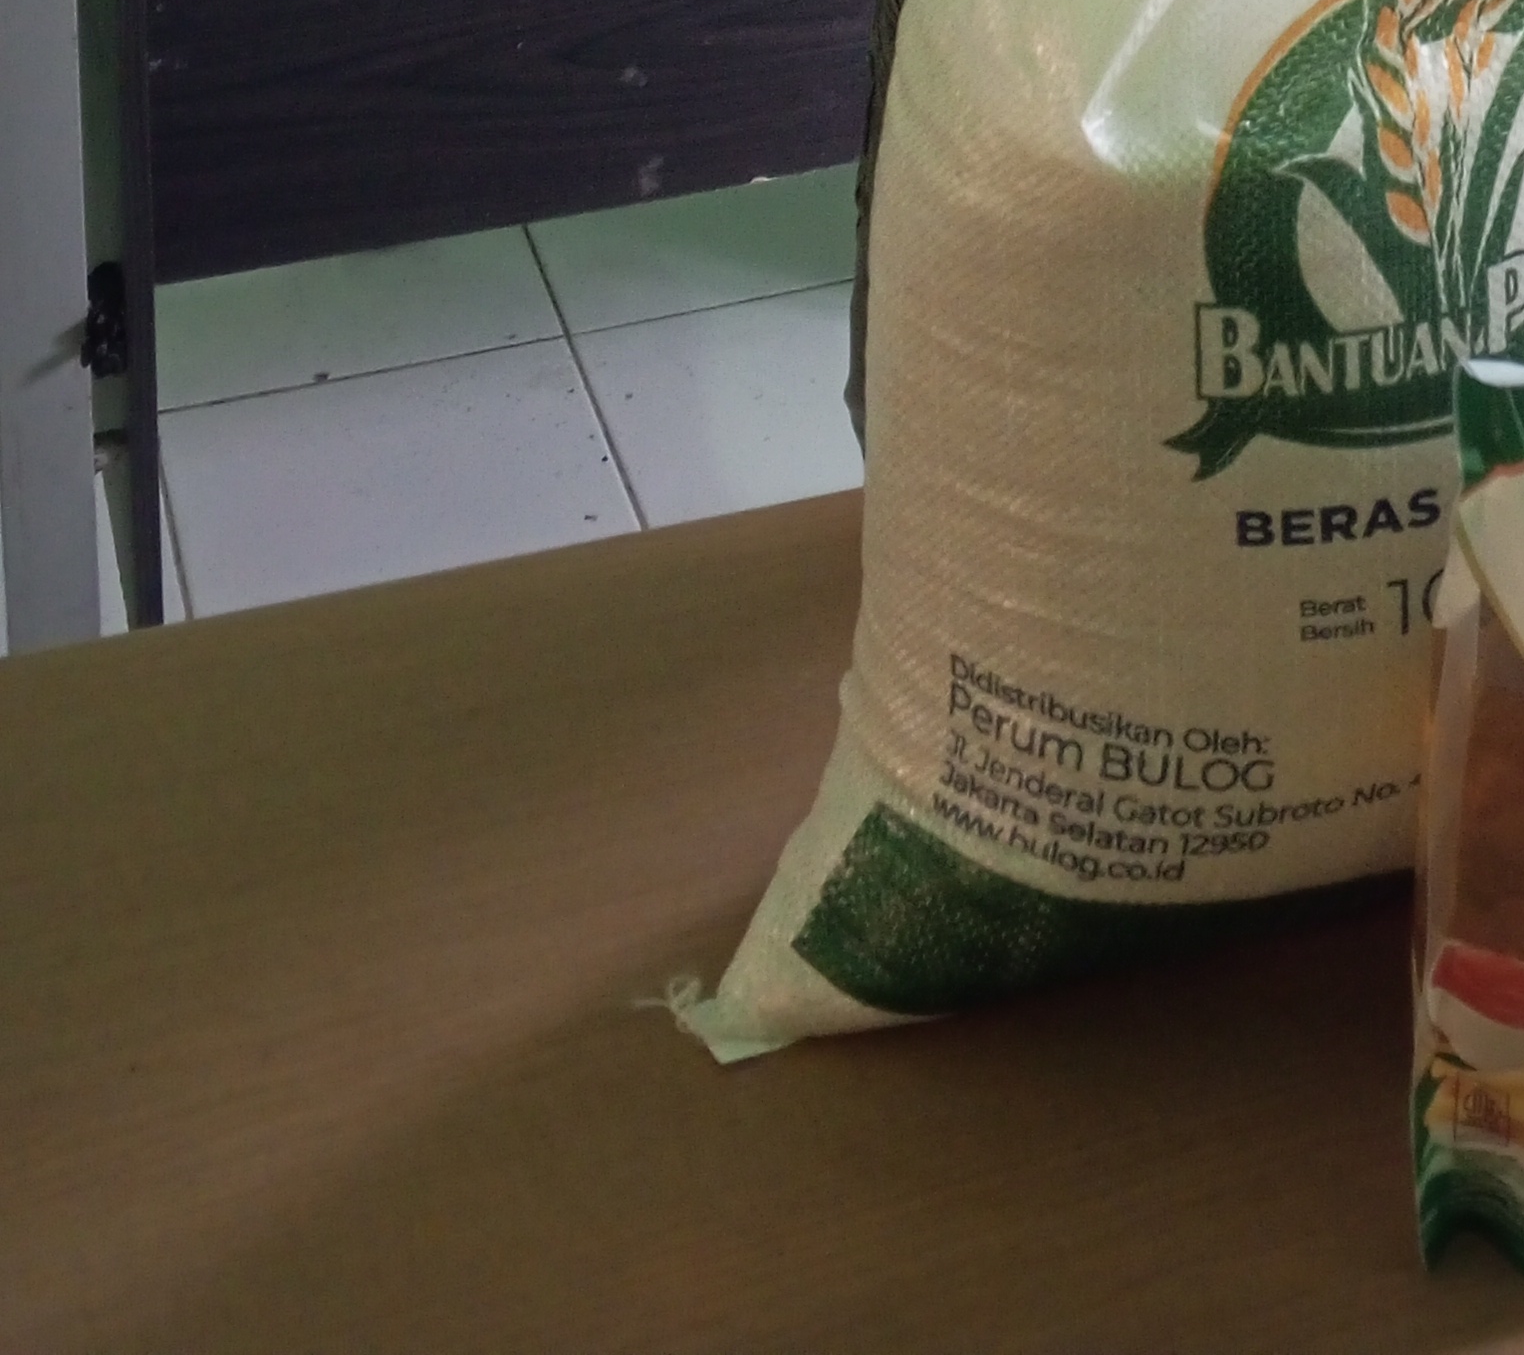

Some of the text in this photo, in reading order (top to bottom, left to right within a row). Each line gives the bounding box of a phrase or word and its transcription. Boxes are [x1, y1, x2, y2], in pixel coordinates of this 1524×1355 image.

[1193, 301, 1482, 402] BANTUAN
[1235, 487, 1442, 548] BERAS
[1300, 594, 1367, 618] Berat
[1300, 618, 1376, 642] Bersih
[949, 653, 1270, 756] Didistribusikan Oleh:
[949, 680, 1277, 793] Perum BULOG
[938, 760, 1040, 827] Jakarta
[1047, 810, 1170, 856] Selatan
[974, 747, 1105, 818] Jenderal
[1112, 794, 1206, 829] Gatot
[1212, 794, 1343, 830] Subroto
